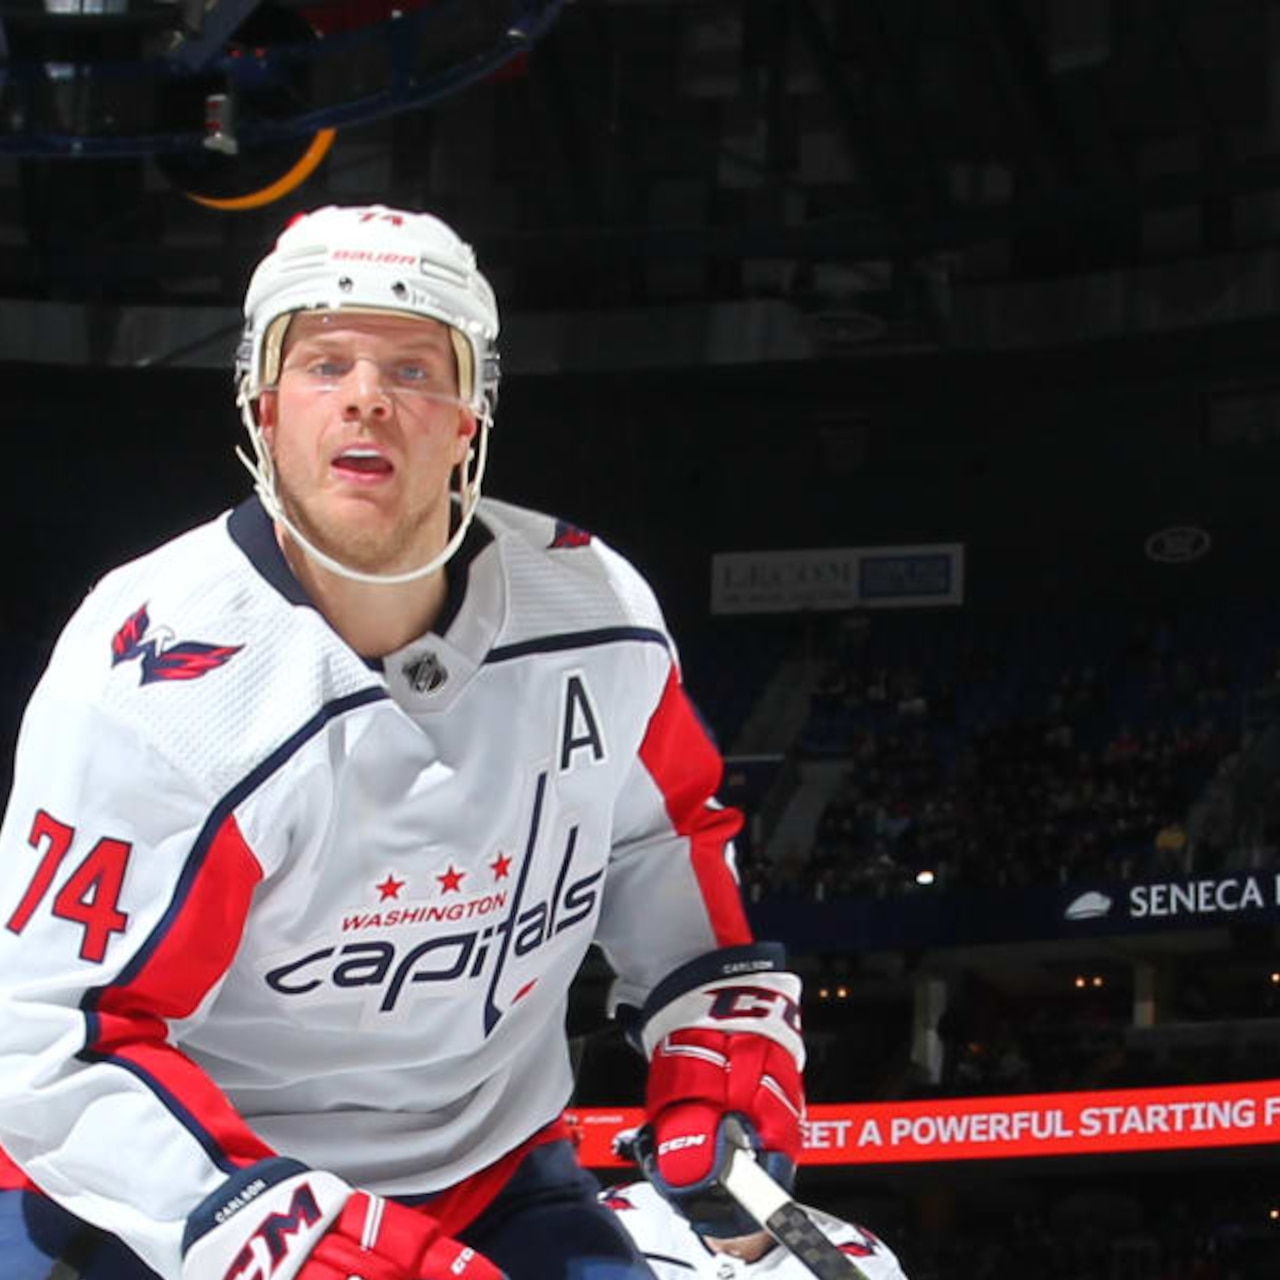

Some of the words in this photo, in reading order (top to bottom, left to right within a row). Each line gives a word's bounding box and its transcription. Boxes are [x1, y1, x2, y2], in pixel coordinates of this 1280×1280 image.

[560, 674, 605, 770] A
[6, 807, 134, 965] 74
[1129, 877, 1264, 919] SENECA
[341, 891, 507, 932] WASHINGTON
[858, 1120, 882, 1147] A
[890, 1108, 1073, 1145] POWERFUL
[1078, 1098, 1257, 1138] STARTING
[214, 1178, 267, 1224] CARLSON
